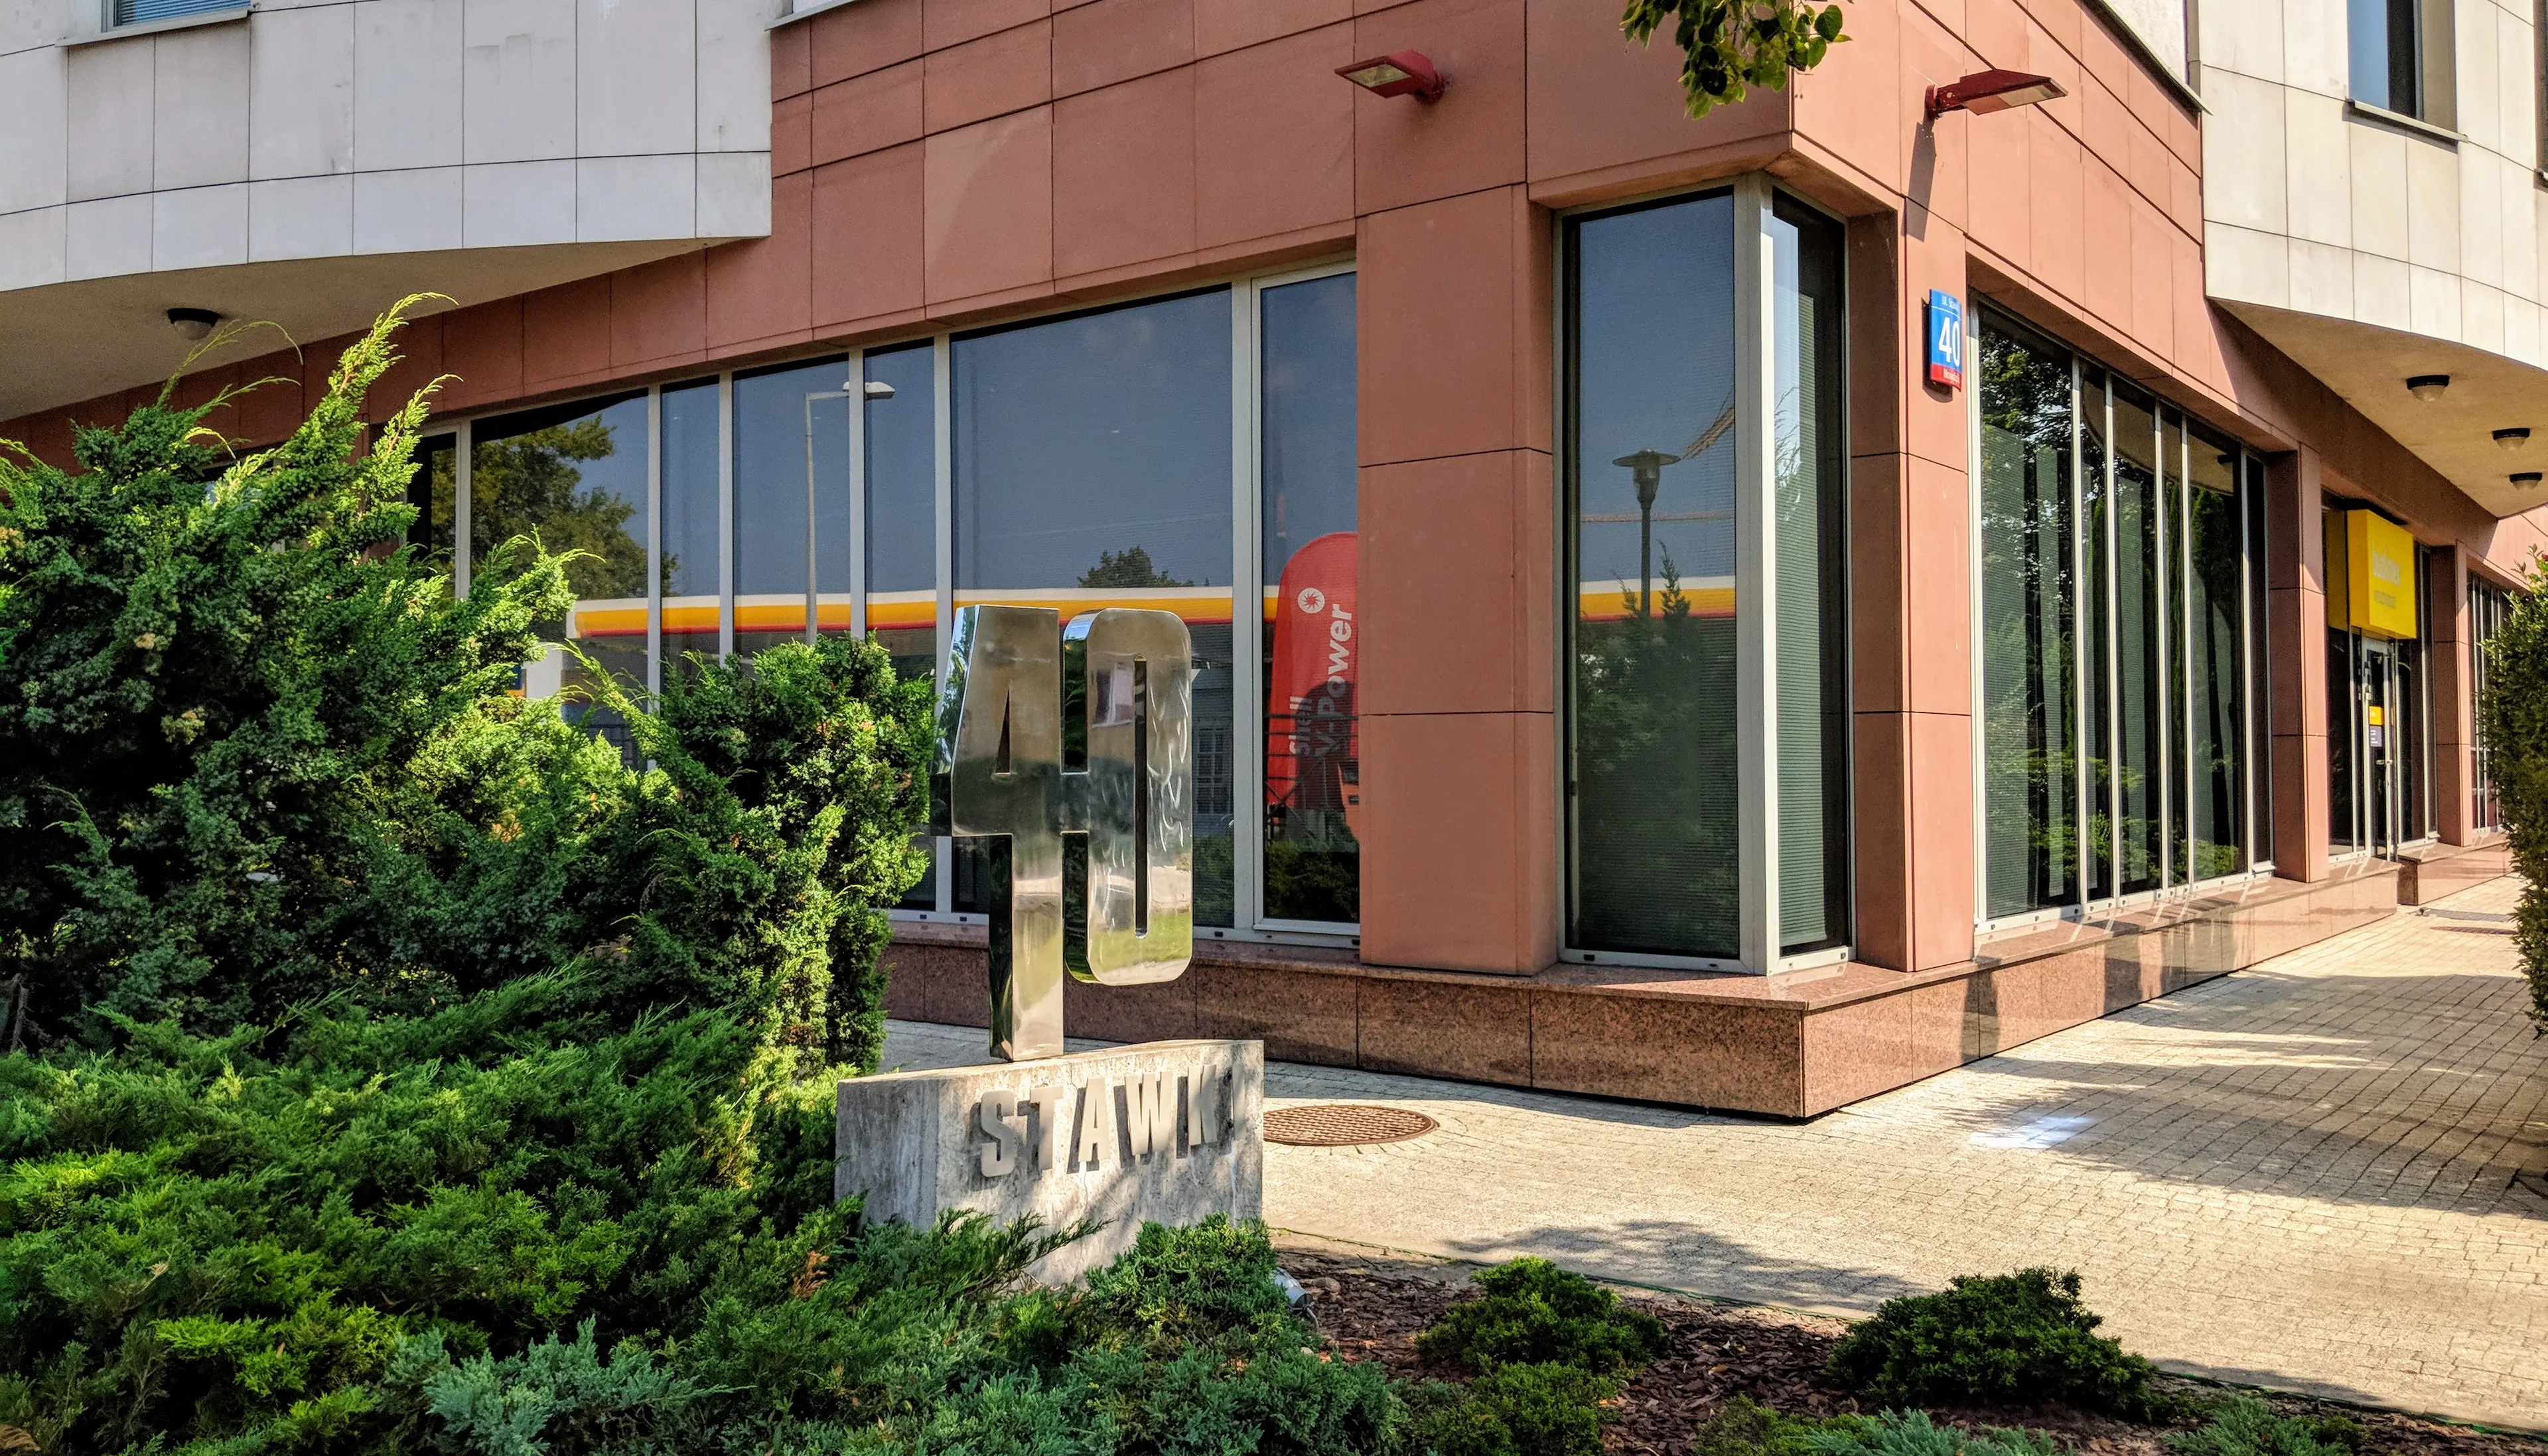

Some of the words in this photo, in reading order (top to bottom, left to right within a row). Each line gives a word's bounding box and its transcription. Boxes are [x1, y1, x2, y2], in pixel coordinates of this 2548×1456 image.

[1938, 316, 1961, 367] 40
[1289, 696, 1312, 756] Shell
[930, 604, 1193, 1061] 40
[980, 1063, 1246, 1177] STAWKI
